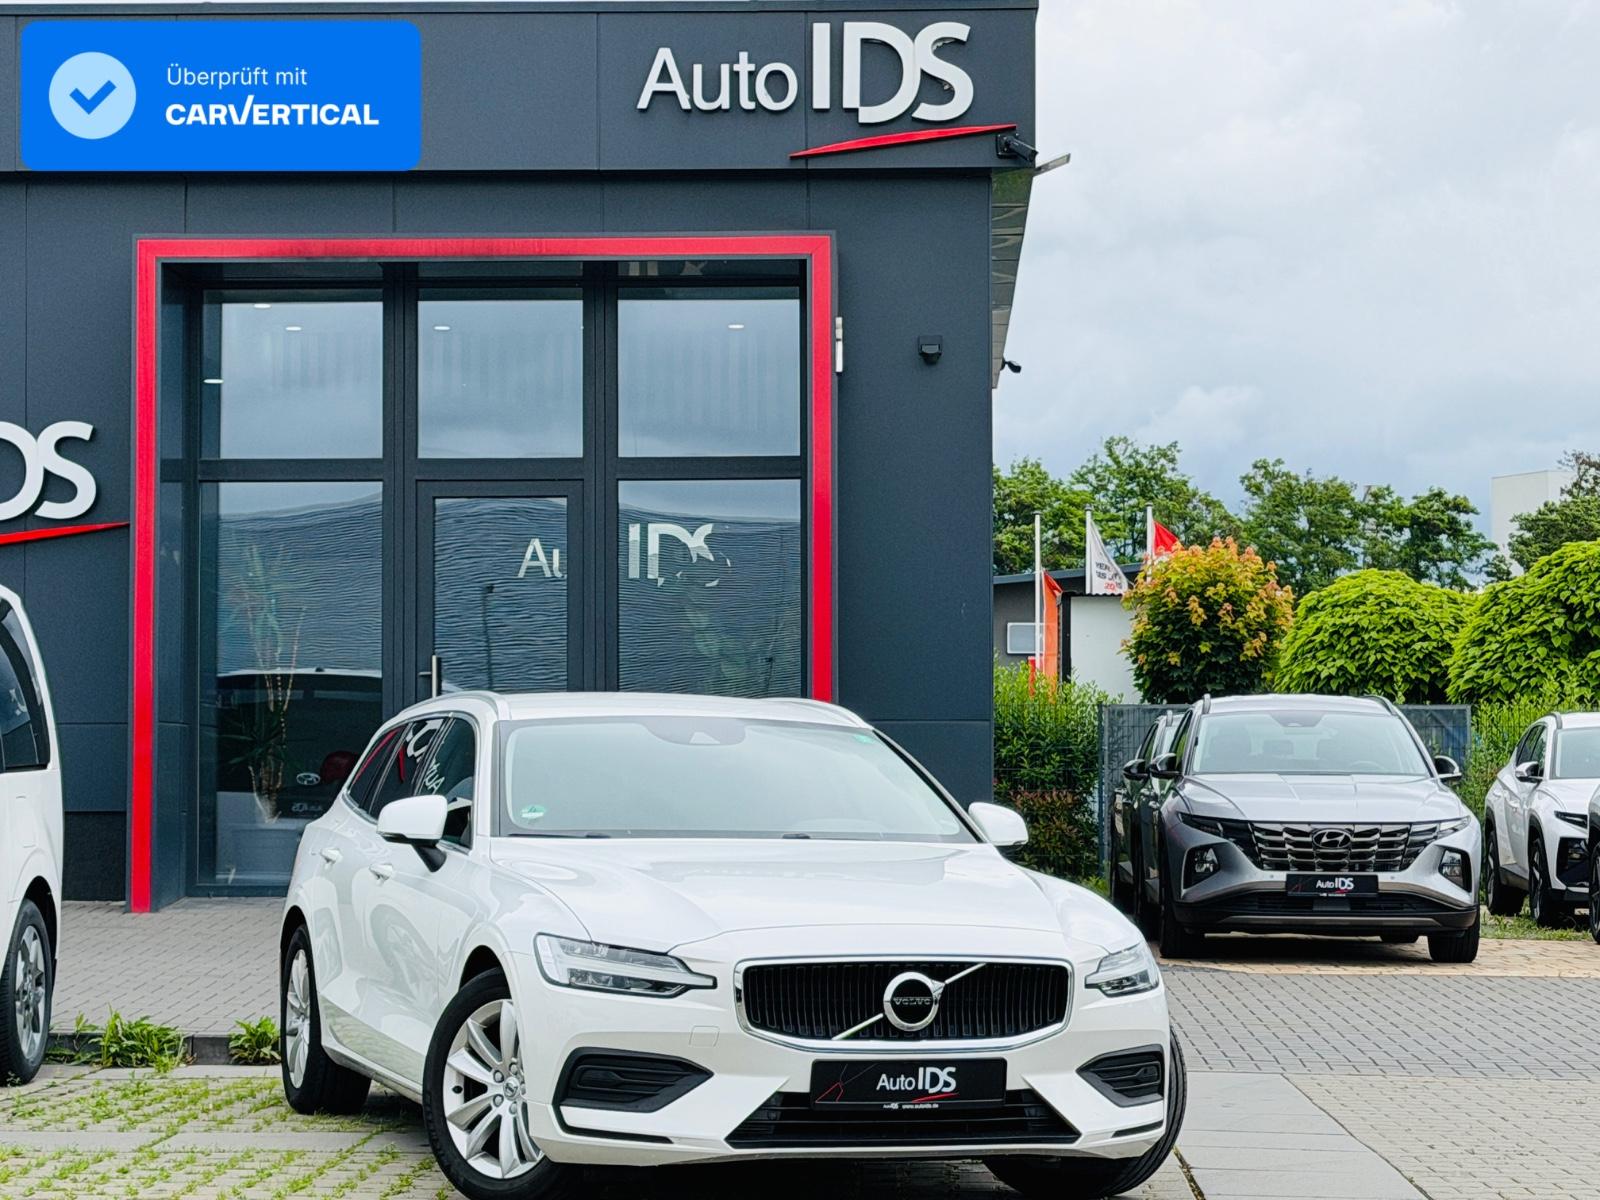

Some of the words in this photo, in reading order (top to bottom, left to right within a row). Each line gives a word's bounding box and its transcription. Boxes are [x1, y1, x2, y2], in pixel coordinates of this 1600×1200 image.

[636, 47, 798, 111] Auto
[812, 21, 974, 123] IDS
[1315, 879, 1335, 889] Auto
[1335, 877, 1355, 890] IDS
[893, 996, 931, 1006] VOLVO
[876, 1073, 916, 1091] Auto
[917, 1066, 957, 1094] IDS
